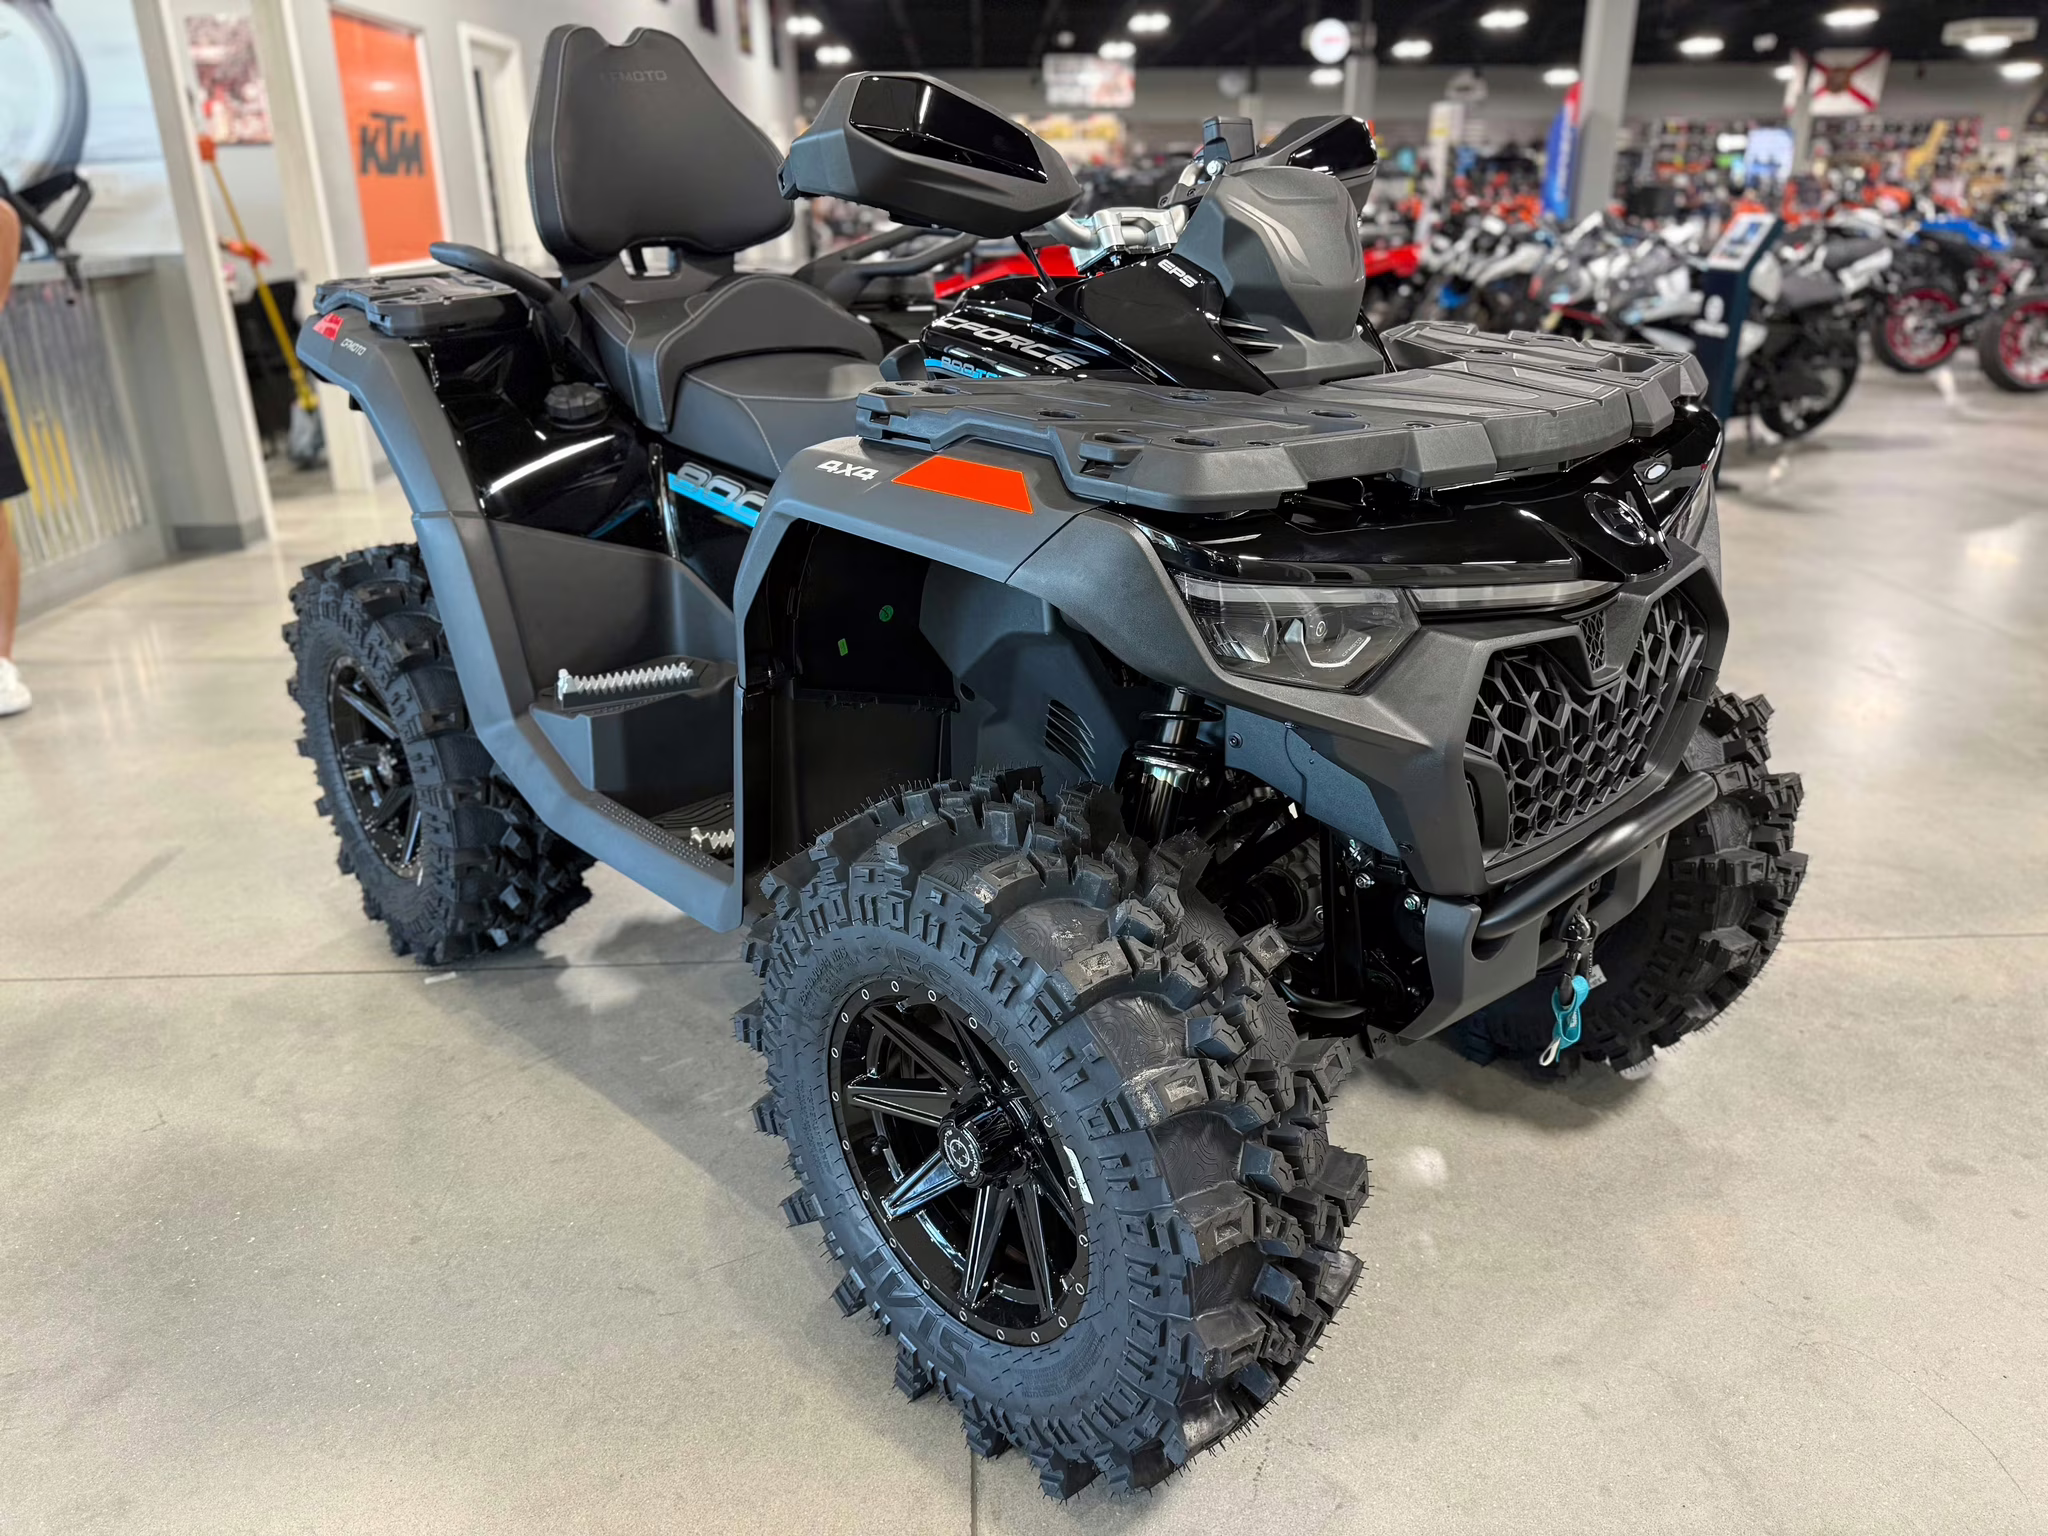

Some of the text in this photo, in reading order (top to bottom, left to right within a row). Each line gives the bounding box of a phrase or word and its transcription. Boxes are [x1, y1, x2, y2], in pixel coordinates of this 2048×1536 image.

[360, 111, 424, 176] KTM
[1157, 259, 1199, 288] EPS
[340, 338, 367, 356] CFMOTO
[941, 317, 1090, 371] CFORCE
